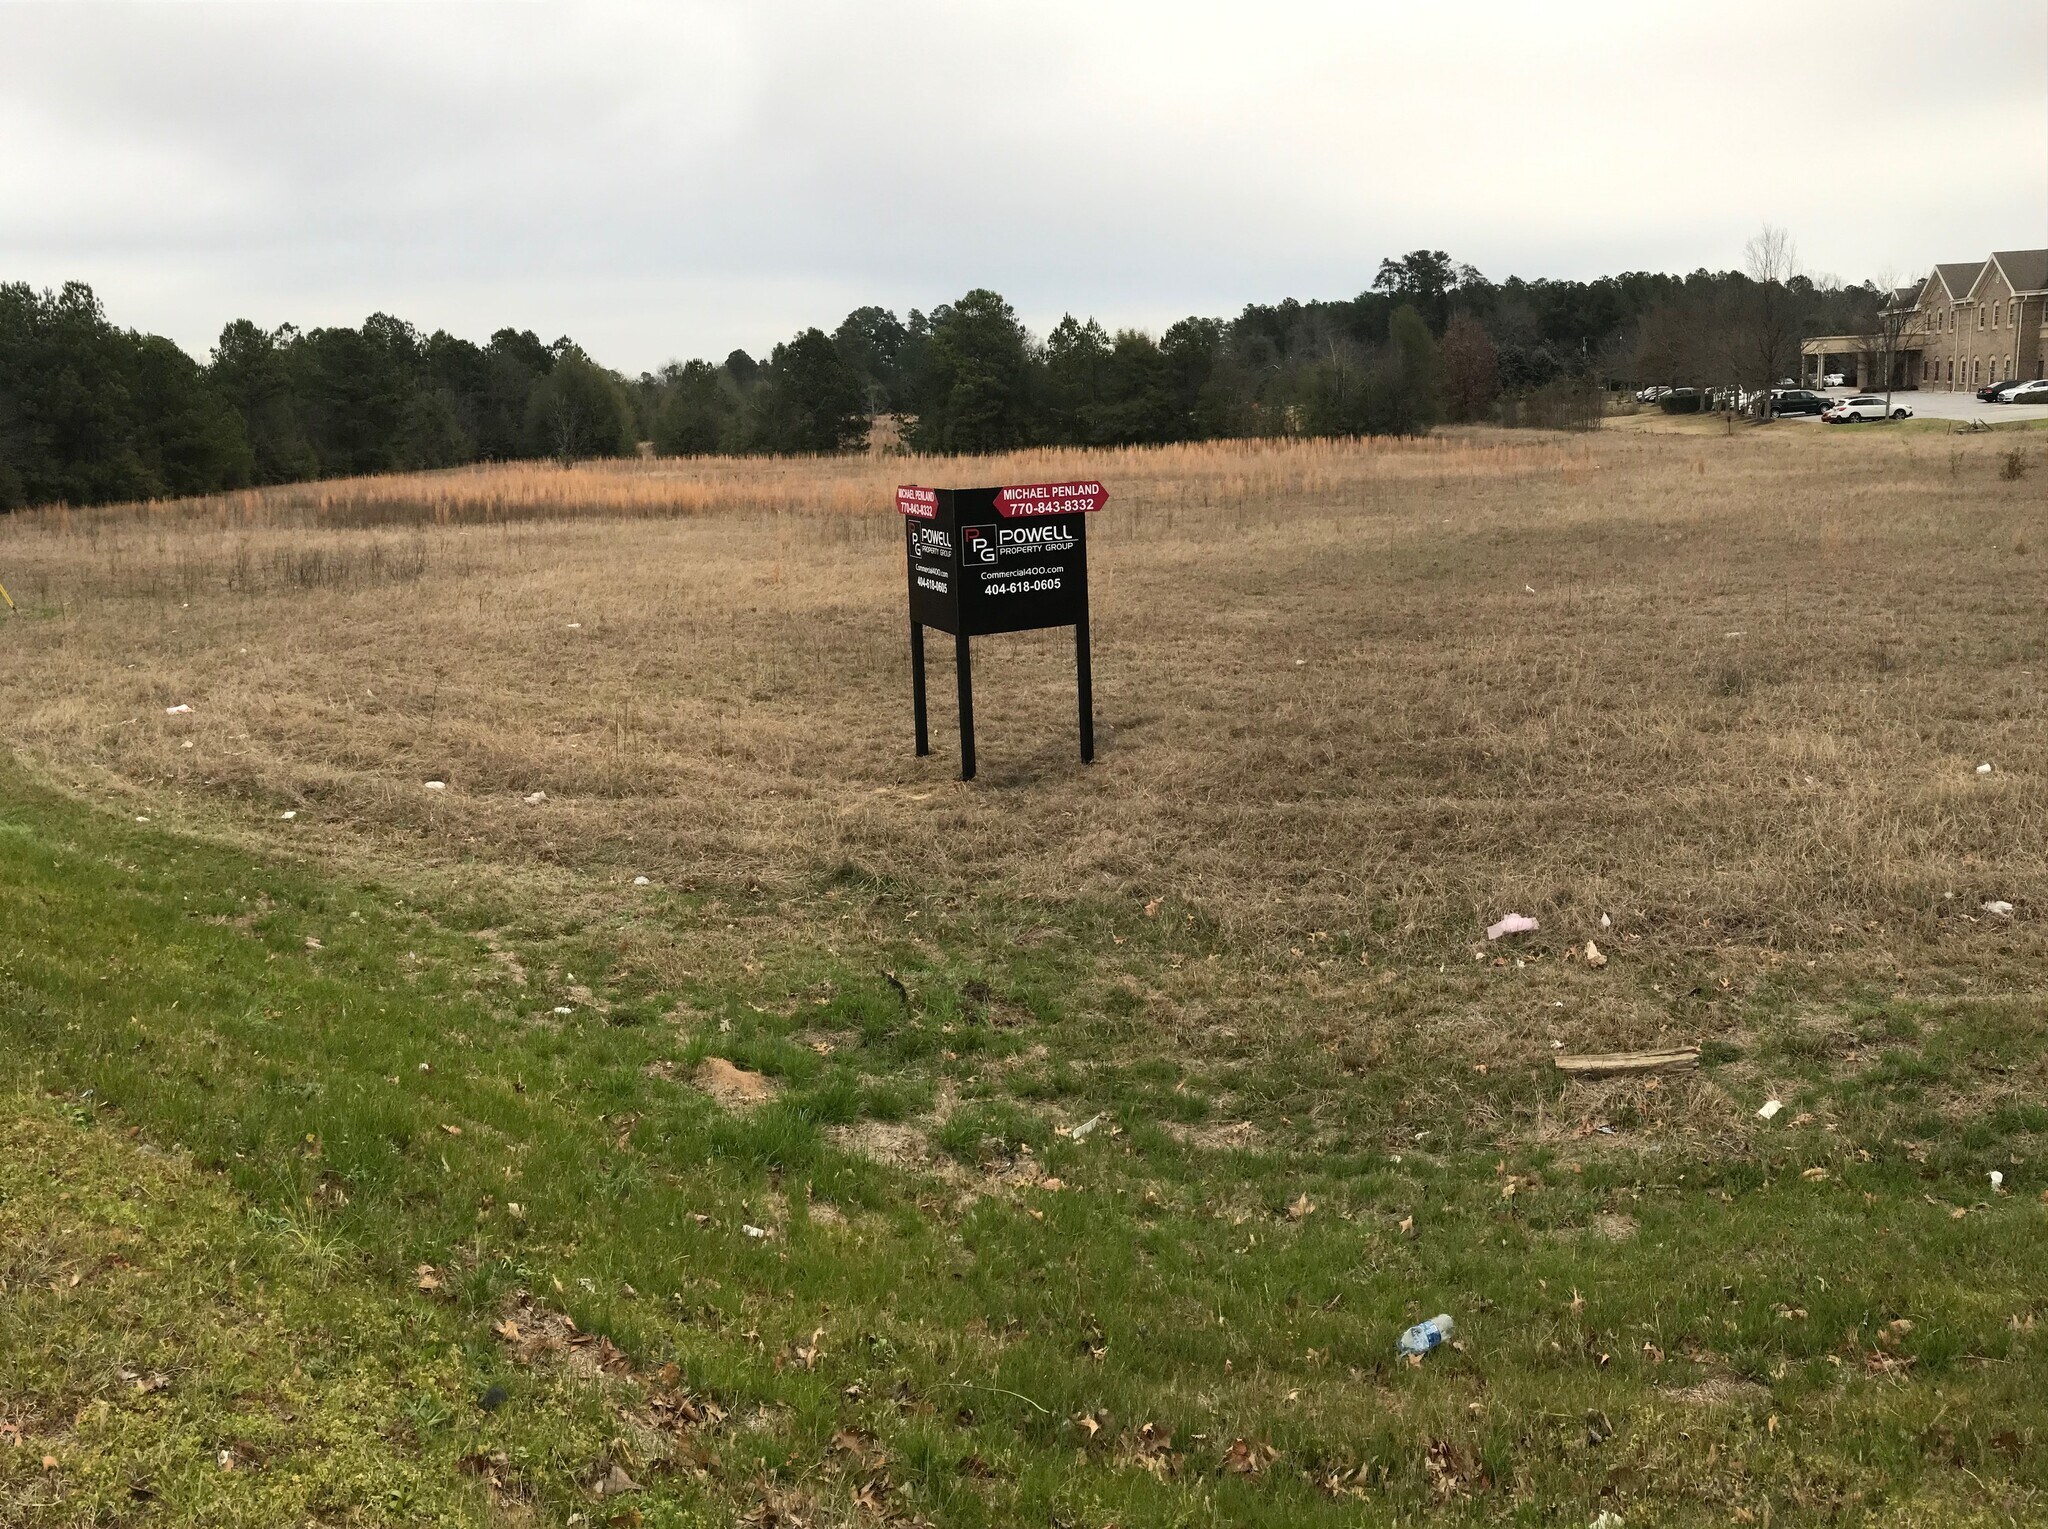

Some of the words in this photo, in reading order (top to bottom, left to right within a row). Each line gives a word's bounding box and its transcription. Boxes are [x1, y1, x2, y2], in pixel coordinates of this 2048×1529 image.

[1003, 486, 1050, 500] MICHAEL
[1052, 484, 1099, 497] PENLAND
[1010, 498, 1094, 515] 770-843-8332
[921, 528, 952, 547] POWELL
[999, 525, 1073, 544] POWELL
[1000, 545, 1042, 555] PROPERTY
[1045, 542, 1074, 552] GROUP
[981, 566, 1064, 580] Commercial400.com
[985, 578, 1061, 596] 404-618-0605
